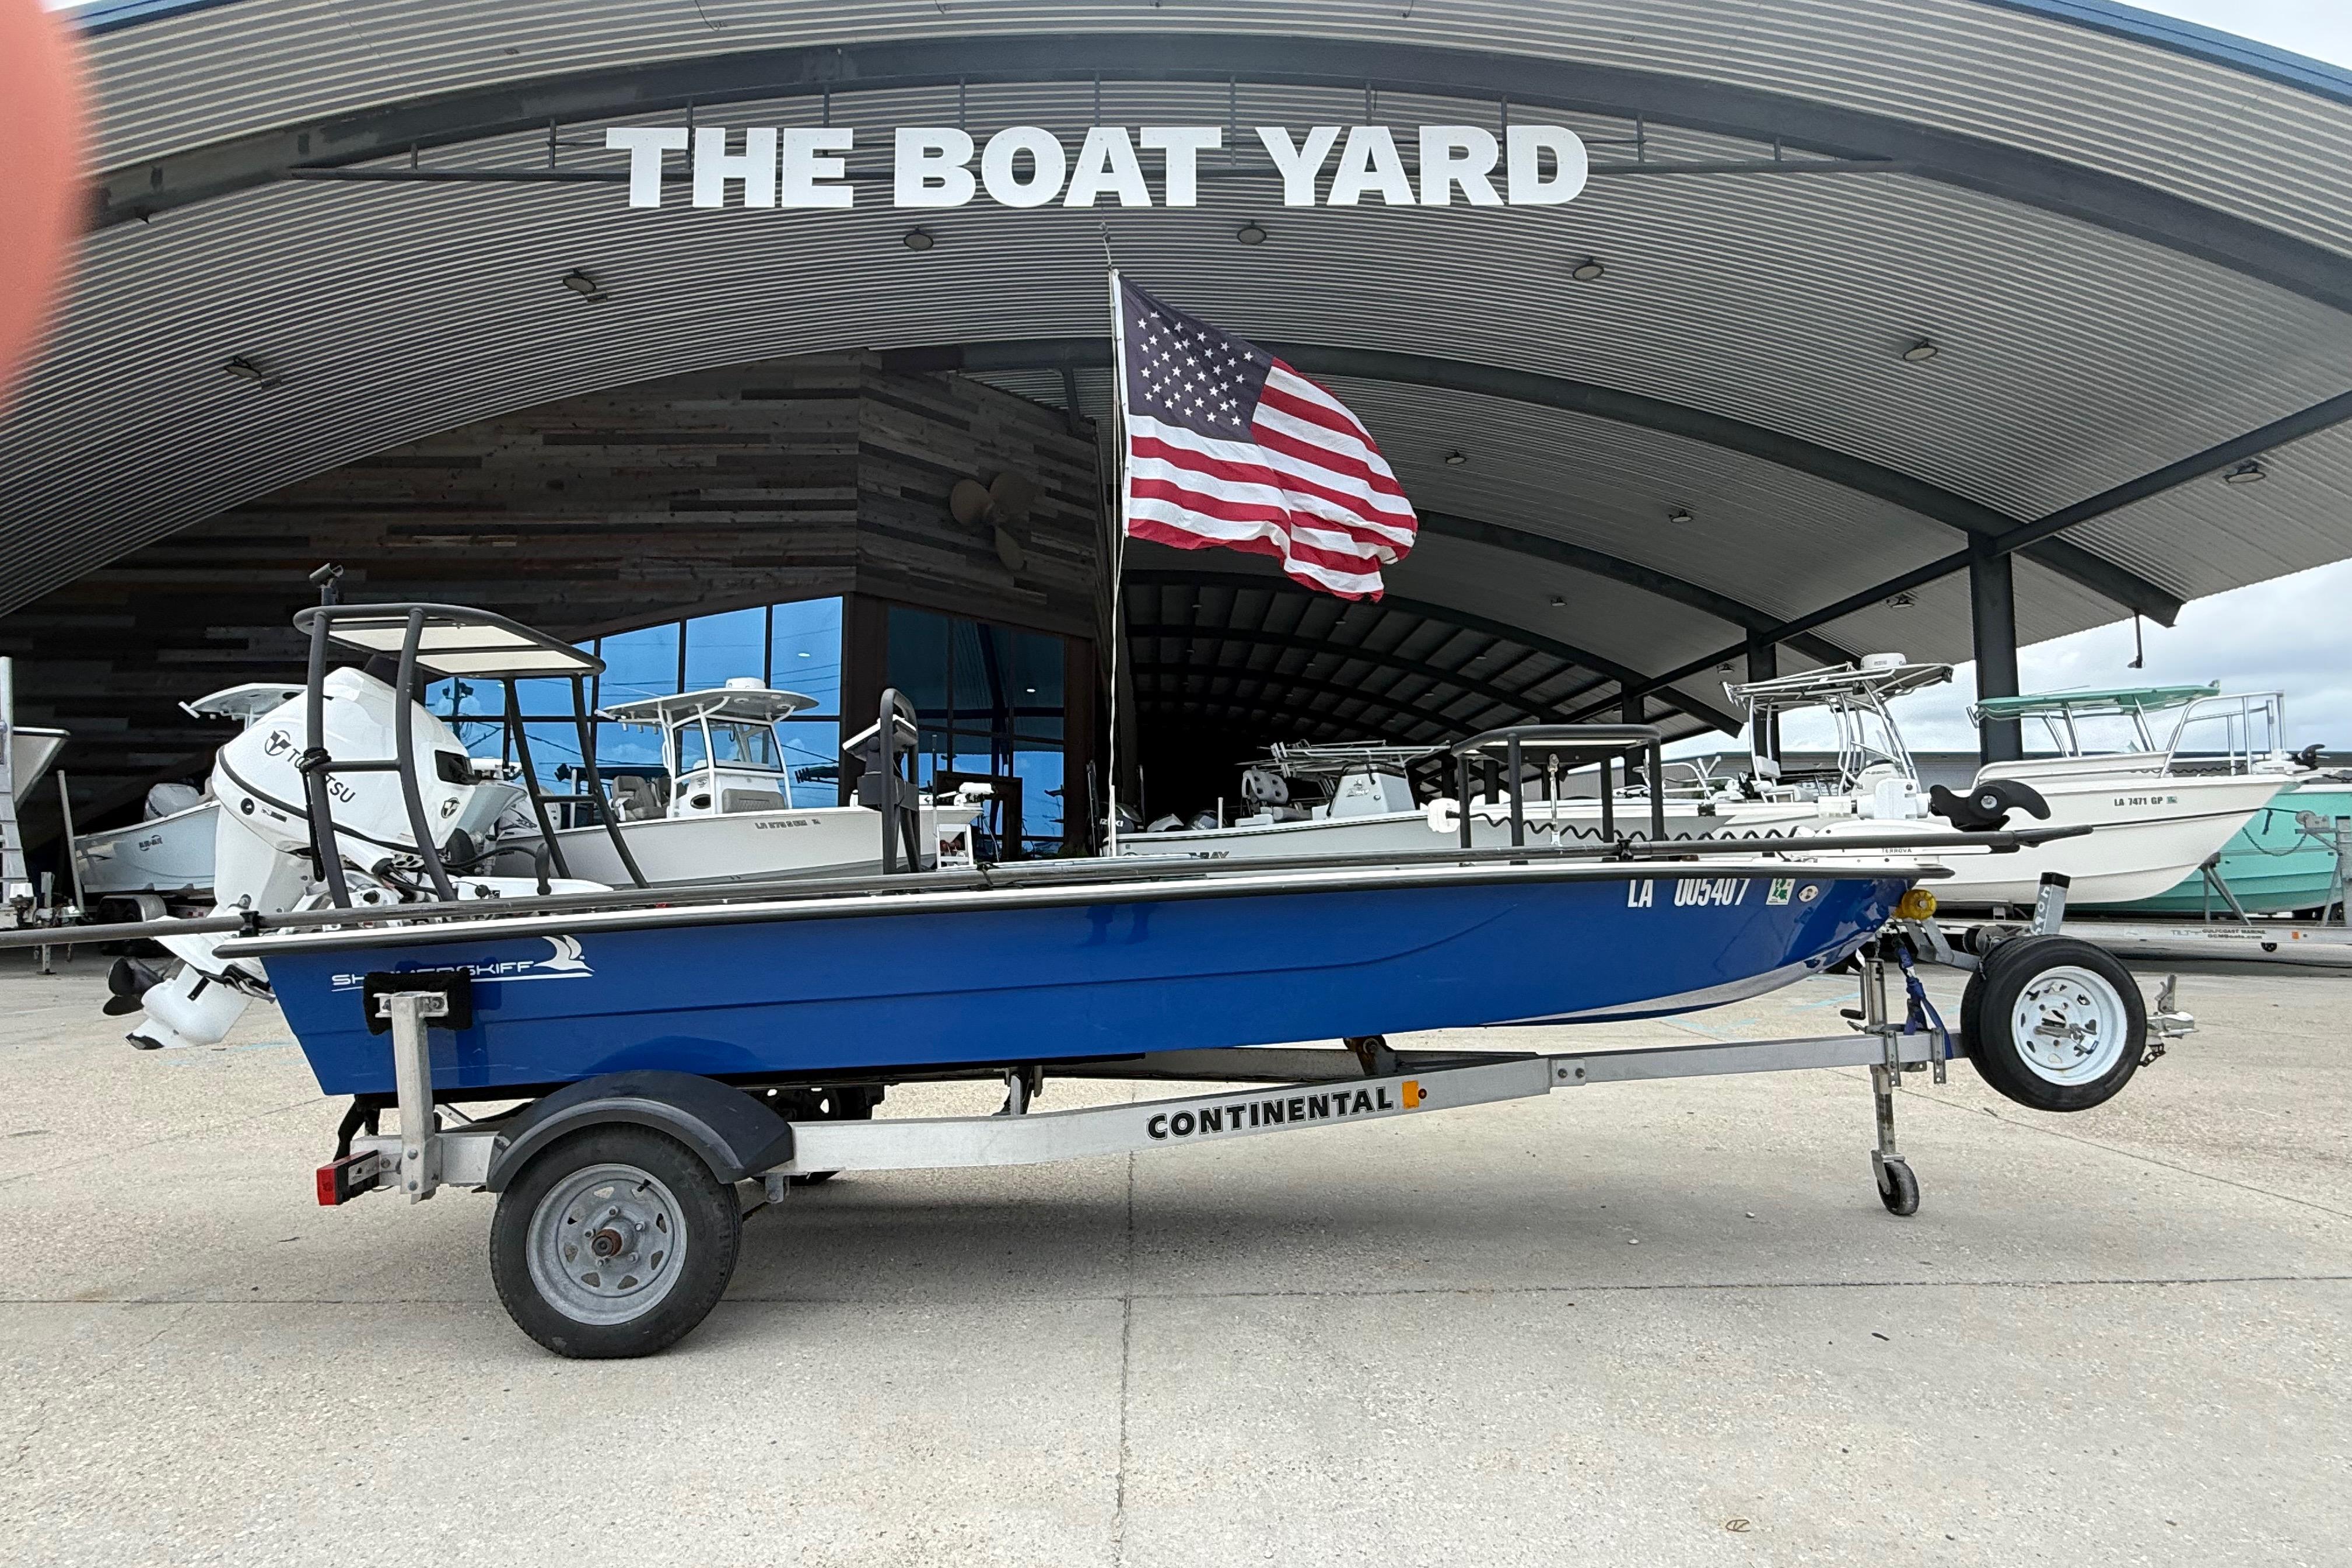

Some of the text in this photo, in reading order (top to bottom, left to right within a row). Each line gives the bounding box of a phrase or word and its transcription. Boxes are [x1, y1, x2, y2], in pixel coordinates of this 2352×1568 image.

[606, 125, 1588, 208] THE BOAT YARD
[2114, 796, 2163, 806] LA 7471 GP
[1628, 878, 1751, 907] LA 005407
[1146, 1086, 1394, 1141] CONTINENTAL
